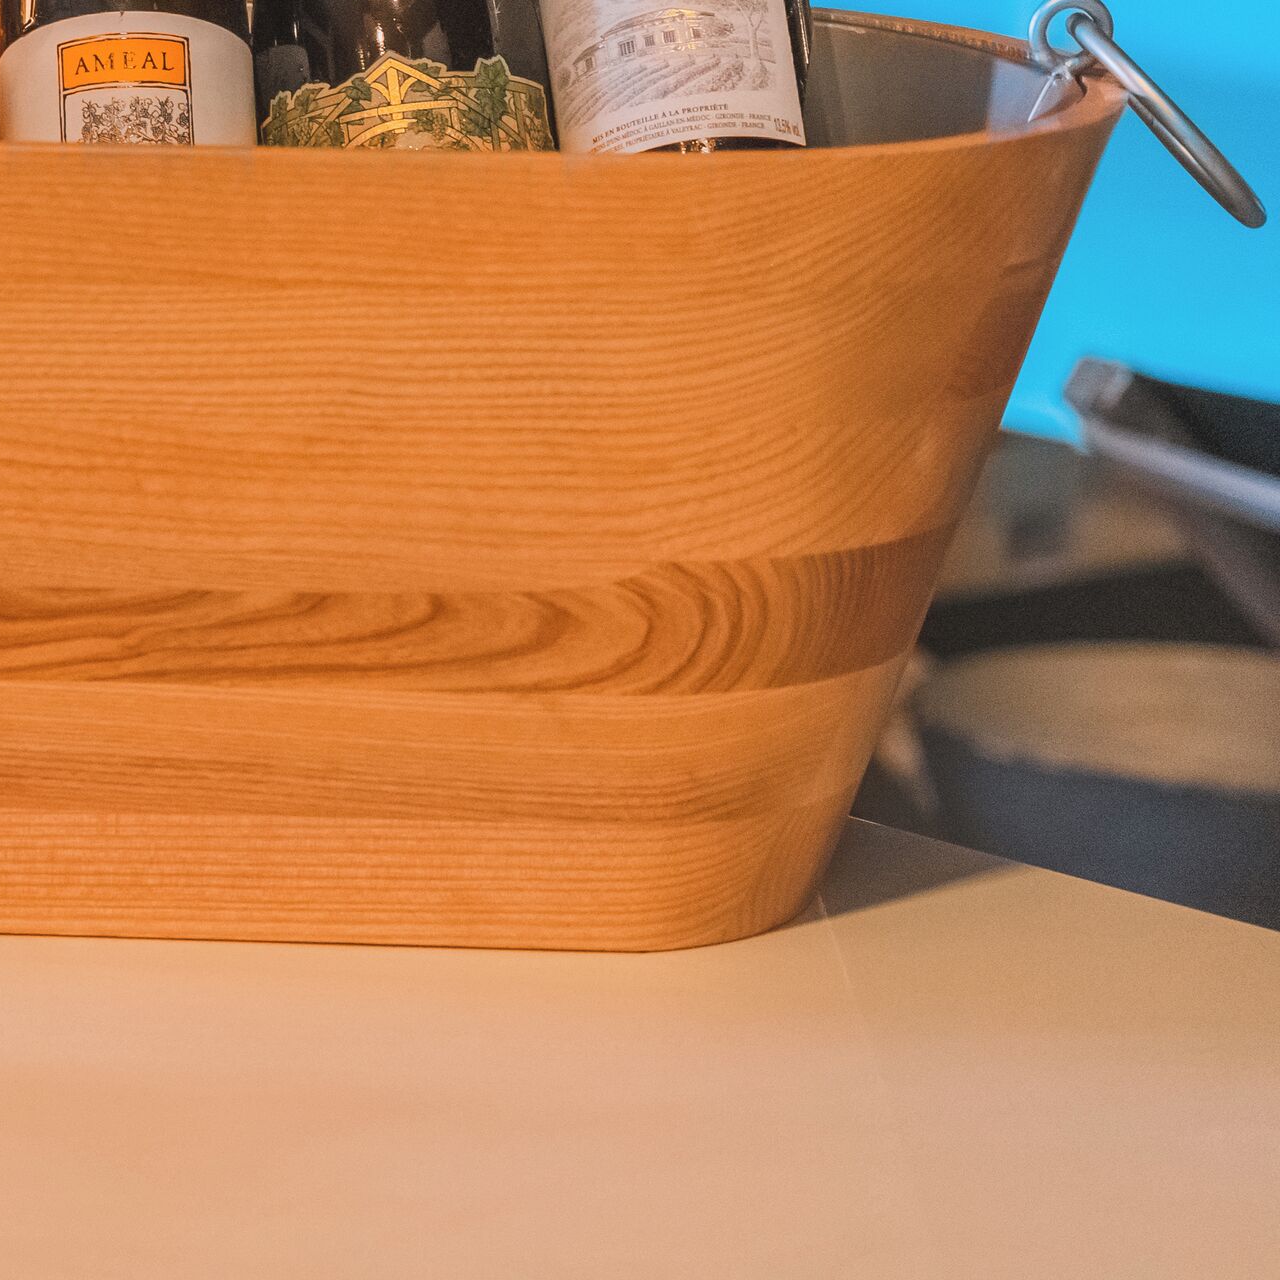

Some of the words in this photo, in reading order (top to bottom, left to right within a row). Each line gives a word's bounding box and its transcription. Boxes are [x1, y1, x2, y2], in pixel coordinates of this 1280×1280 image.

[74, 51, 175, 75] AMEAL
[604, 127, 616, 138] EN
[615, 113, 659, 133] BOUTEILLE
[668, 109, 680, 117] LA
[681, 103, 729, 114] PROPRIÉTÉ
